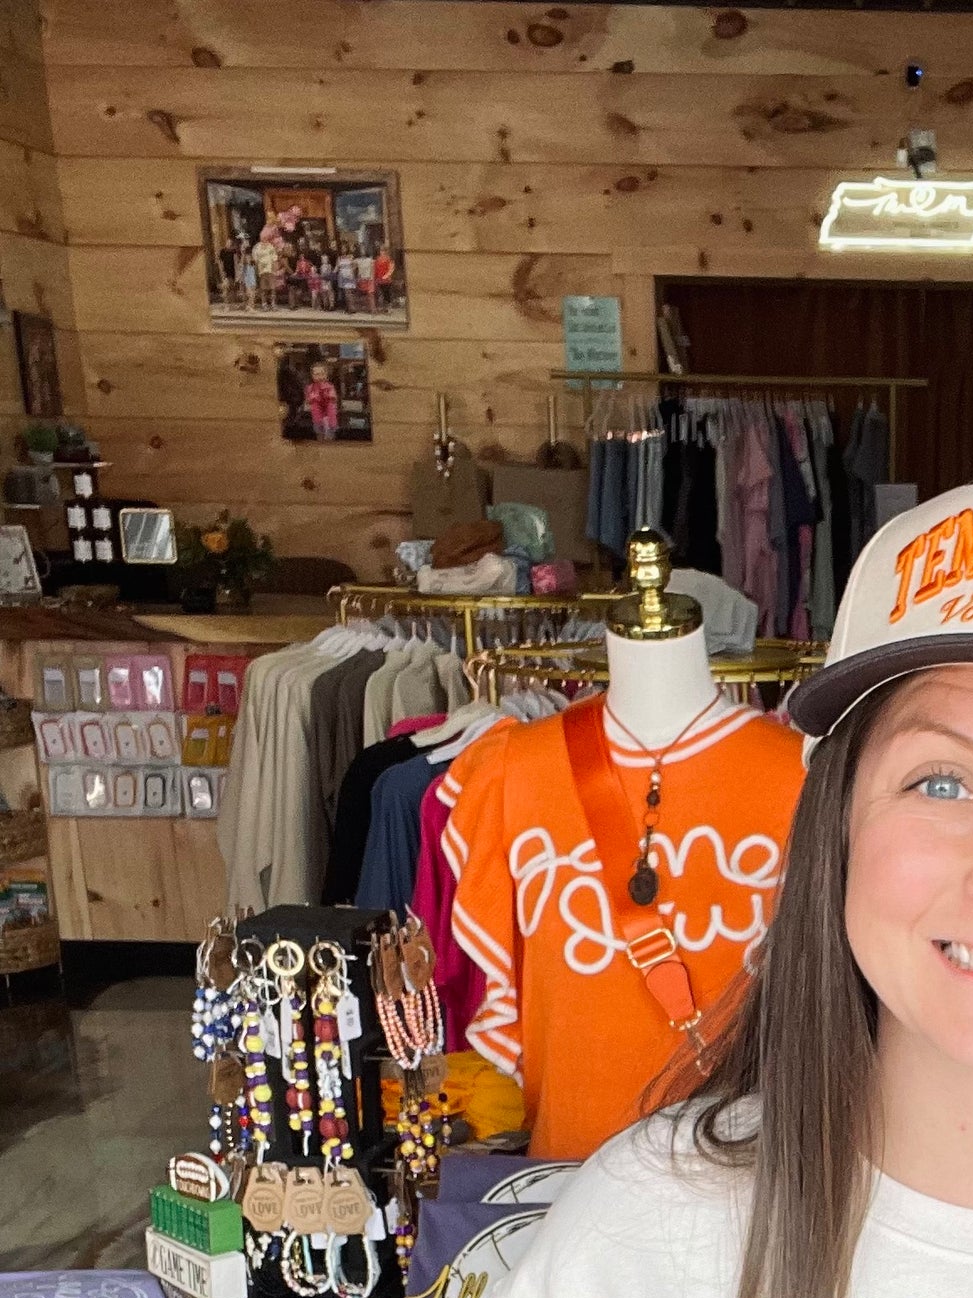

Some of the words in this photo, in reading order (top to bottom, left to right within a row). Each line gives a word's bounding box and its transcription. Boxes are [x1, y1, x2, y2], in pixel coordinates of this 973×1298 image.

[251, 1202, 279, 1217] LOVE
[332, 1202, 361, 1219] LOVE
[160, 1243, 186, 1286] GAME
[185, 1257, 209, 1298] TIME
